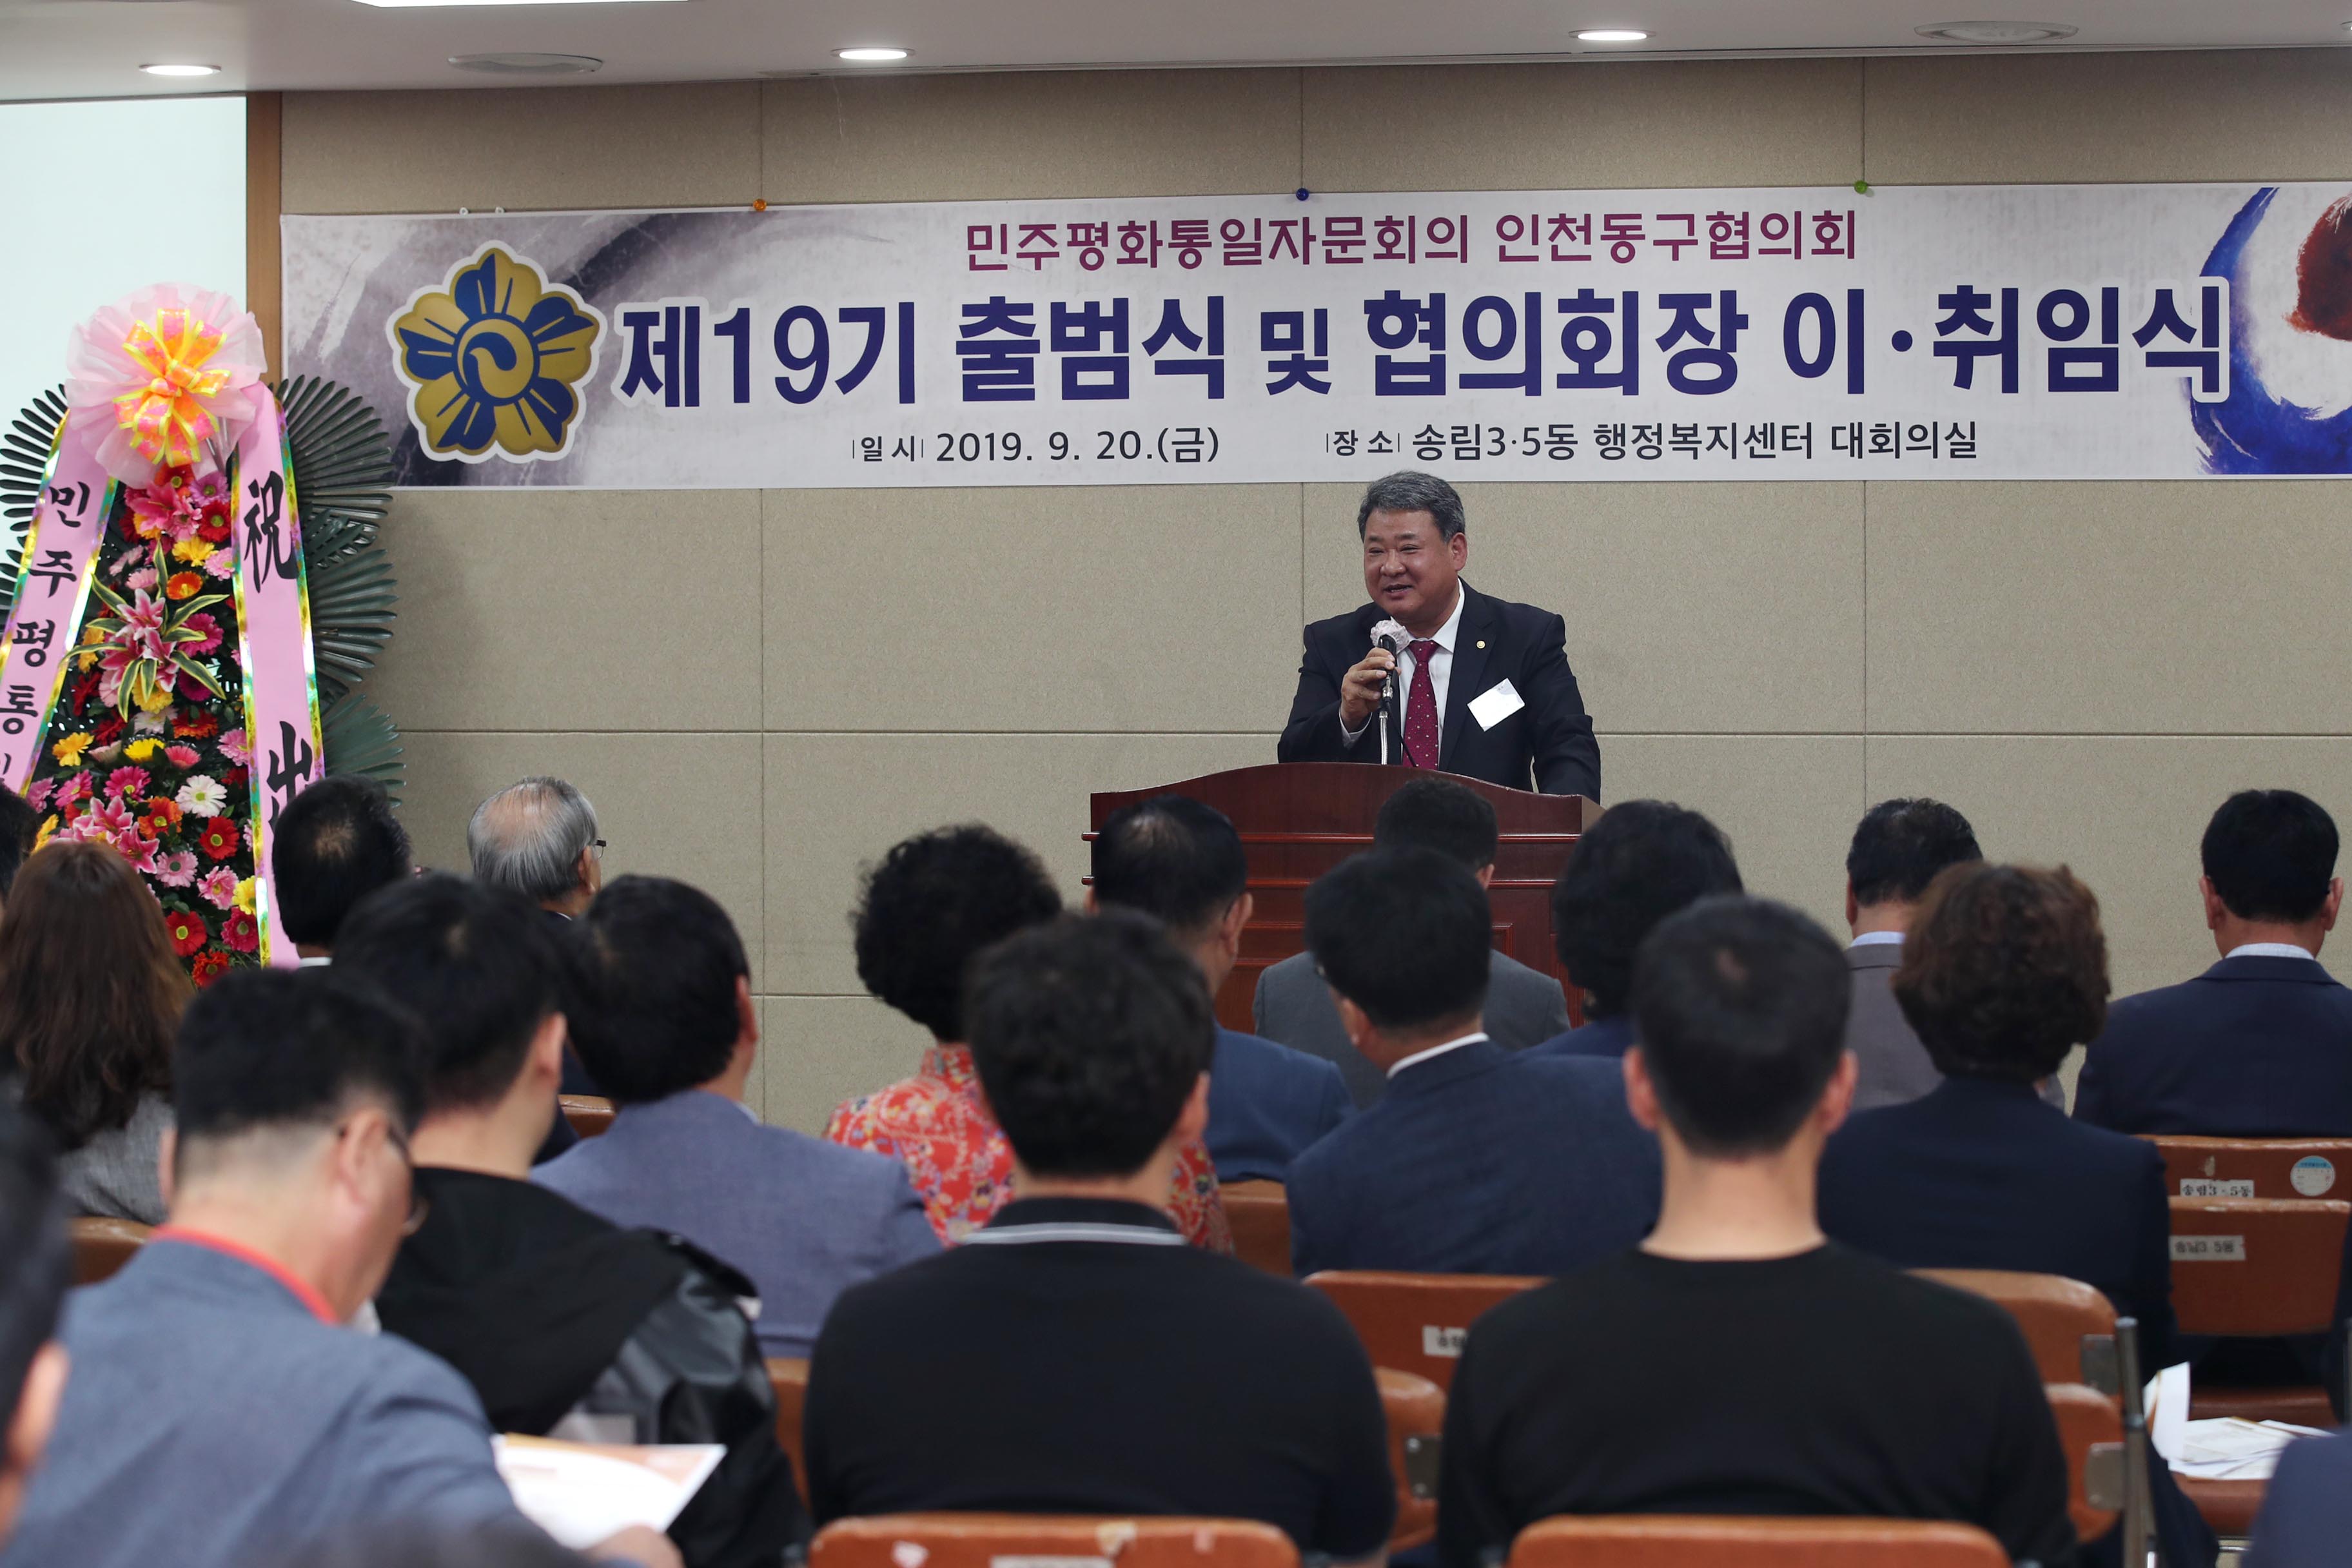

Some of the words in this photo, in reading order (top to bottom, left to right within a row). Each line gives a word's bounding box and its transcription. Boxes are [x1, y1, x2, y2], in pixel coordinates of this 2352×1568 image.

[967, 214, 1468, 271] 민주평화통일자문회의
[1495, 210, 1856, 264] 인천동구협의회
[620, 301, 916, 407] 제19기
[956, 295, 1225, 402] 출범식
[1260, 308, 1333, 397] 및
[1364, 288, 1749, 397] 협의회장
[1783, 284, 2220, 395] 이·취임식
[936, 432, 1033, 462] 2019.
[1048, 431, 1080, 462] 9.
[1096, 426, 1220, 464] 20.(금)
[1412, 423, 1579, 462] 송림3·5동
[1592, 421, 1813, 461] 행정복지센터
[1831, 420, 1977, 460] 대회의실
[244, 469, 300, 593] 祝
[0, 480, 90, 775] 민주평통
